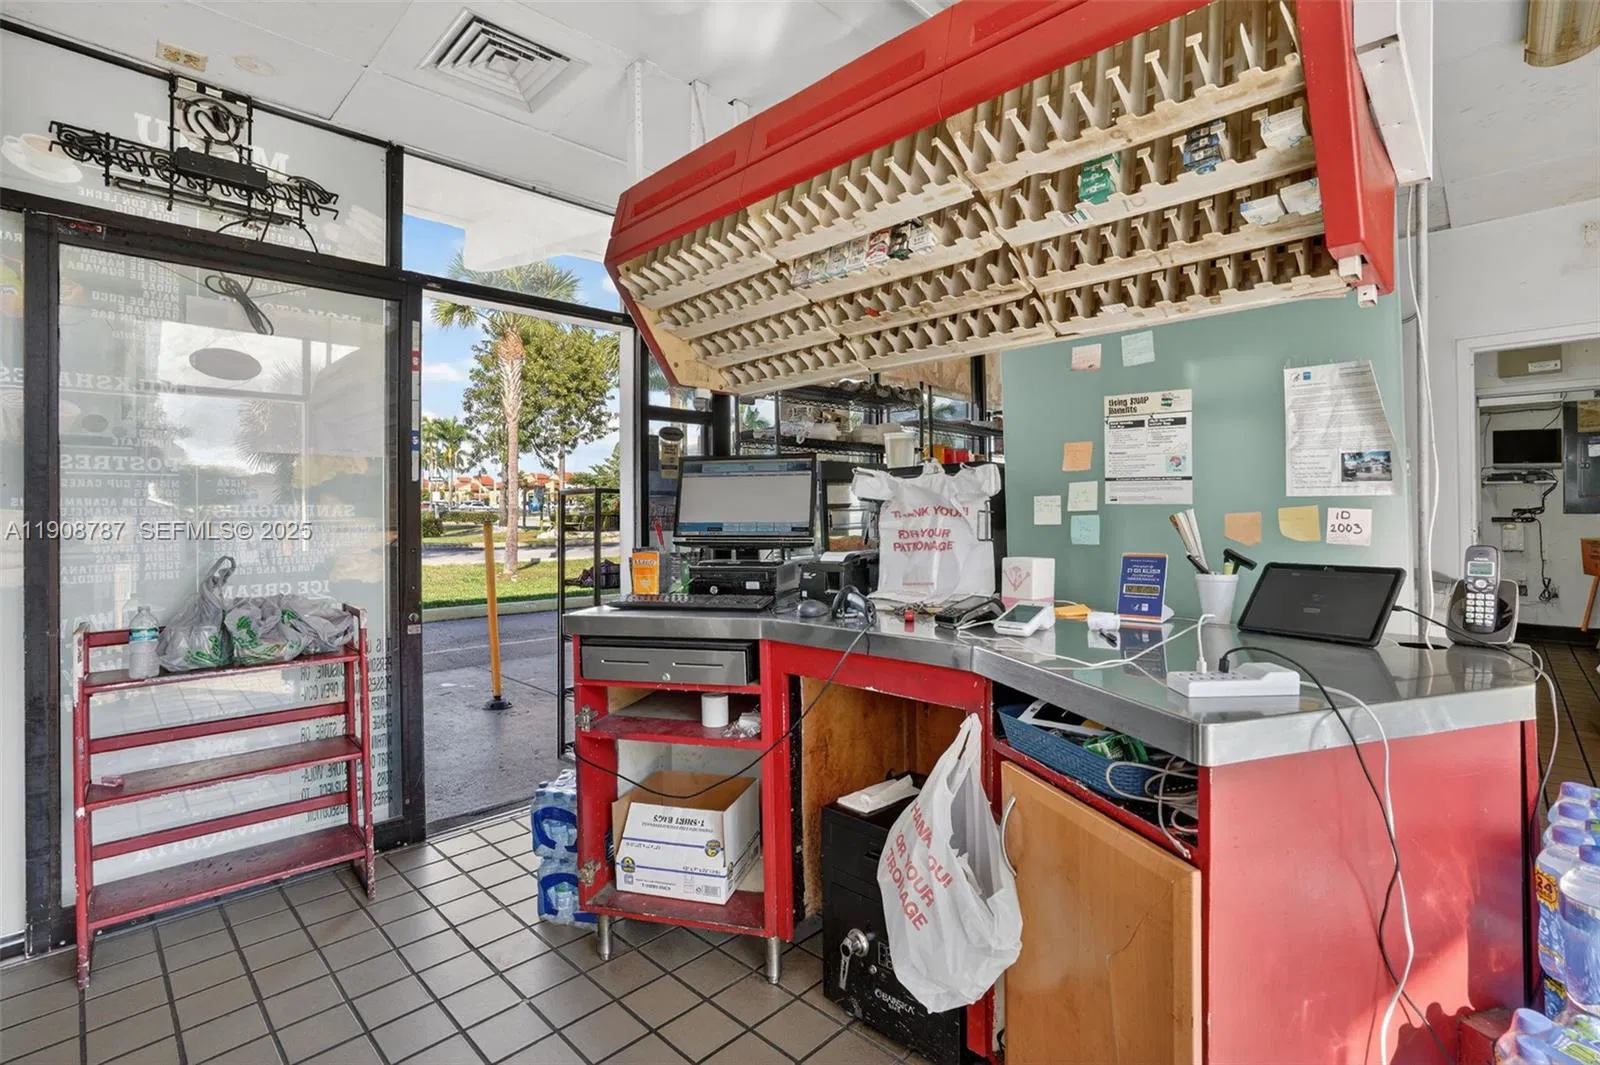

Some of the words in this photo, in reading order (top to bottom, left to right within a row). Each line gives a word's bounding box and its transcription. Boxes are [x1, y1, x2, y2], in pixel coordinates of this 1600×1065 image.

[890, 506, 929, 519] TNK
[920, 528, 952, 539] YOUR
[1330, 523, 1364, 535] 2003
[911, 801, 933, 849] HANK
[896, 833, 907, 857] OR
